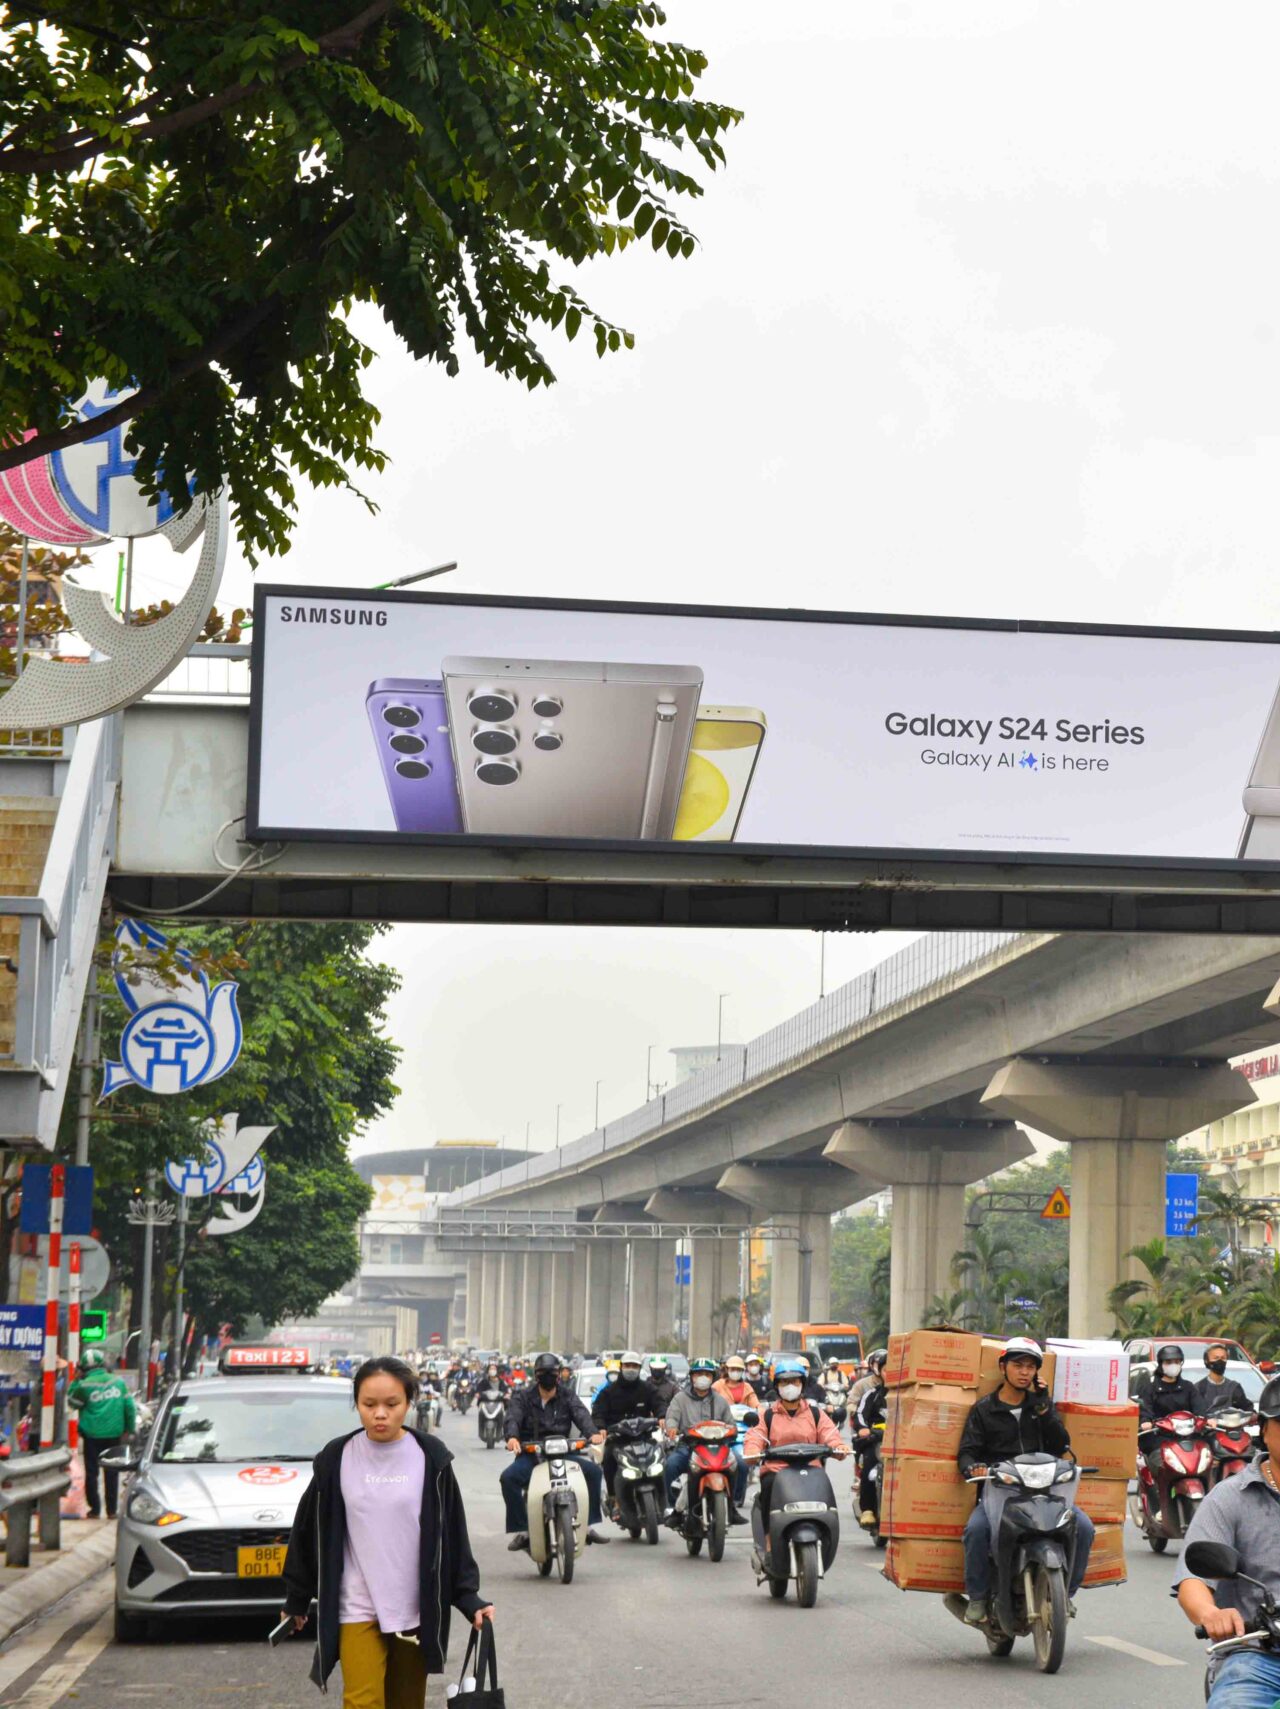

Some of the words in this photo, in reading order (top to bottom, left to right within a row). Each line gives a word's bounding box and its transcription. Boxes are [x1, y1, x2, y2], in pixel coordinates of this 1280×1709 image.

[281, 606, 388, 626] SAMSUNG
[885, 712, 992, 745] Galaxy
[999, 717, 1048, 741] S24
[1056, 719, 1145, 745] Series
[921, 748, 992, 772] Galaxy
[997, 752, 1015, 768] AI
[1042, 754, 1056, 770] is
[1063, 754, 1110, 772] here
[235, 1351, 267, 1362] Taxi
[272, 1351, 305, 1363] 123
[90, 1386, 121, 1402] Grab
[244, 1562, 282, 1576] 001.1
